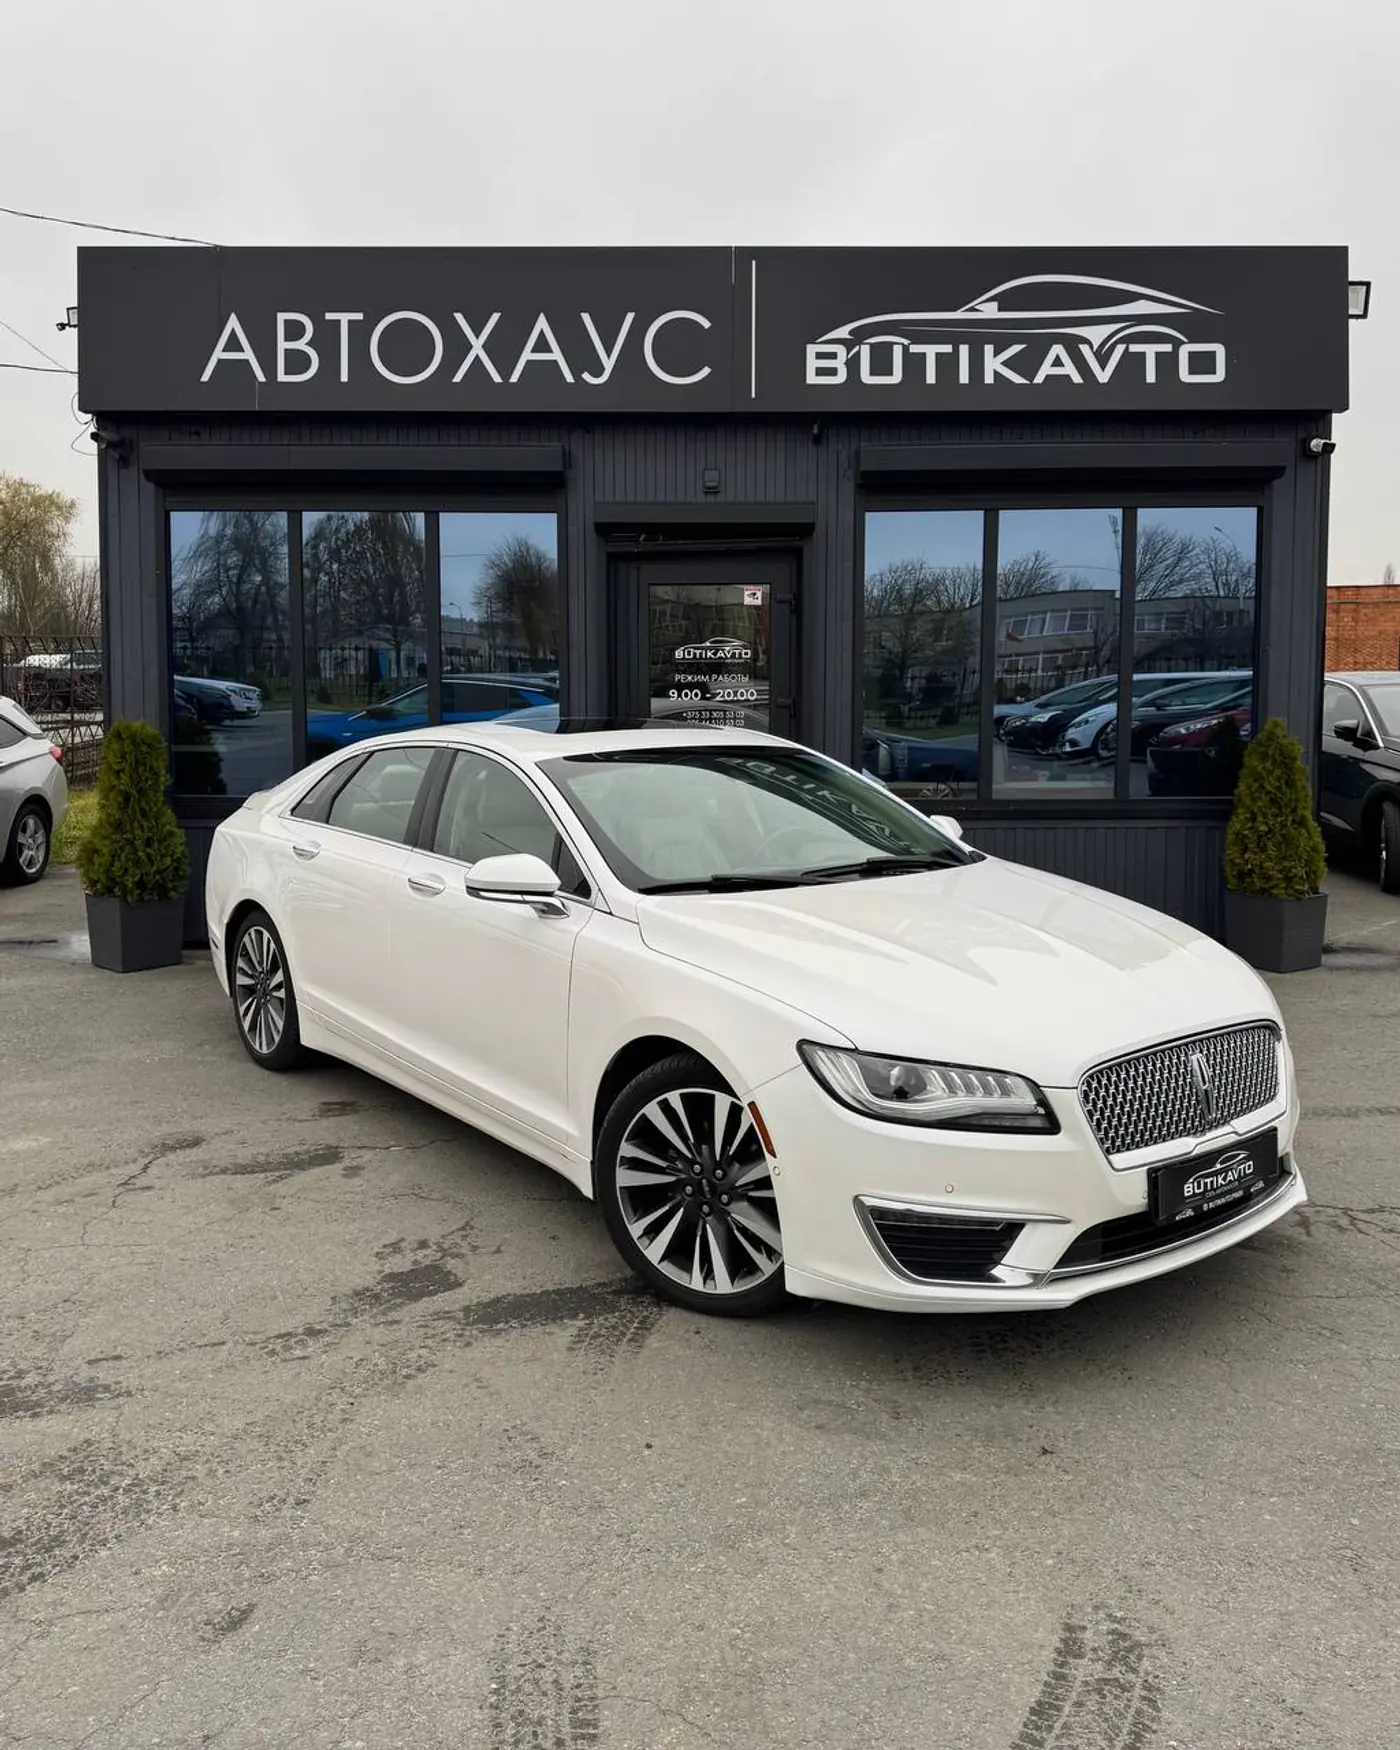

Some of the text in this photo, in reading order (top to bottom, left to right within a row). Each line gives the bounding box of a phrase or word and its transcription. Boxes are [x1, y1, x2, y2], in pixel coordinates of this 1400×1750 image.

[200, 310, 712, 385] АВТОХАУС
[806, 342, 1226, 385] BUTIKAVTO
[675, 648, 752, 659] BUTIKAVTO
[675, 674, 749, 683] РЕЖИМ РАБОТЫ
[669, 689, 701, 701] 9.00
[715, 689, 757, 701] 20.00
[1184, 1160, 1253, 1196] BUTIKAVTO
